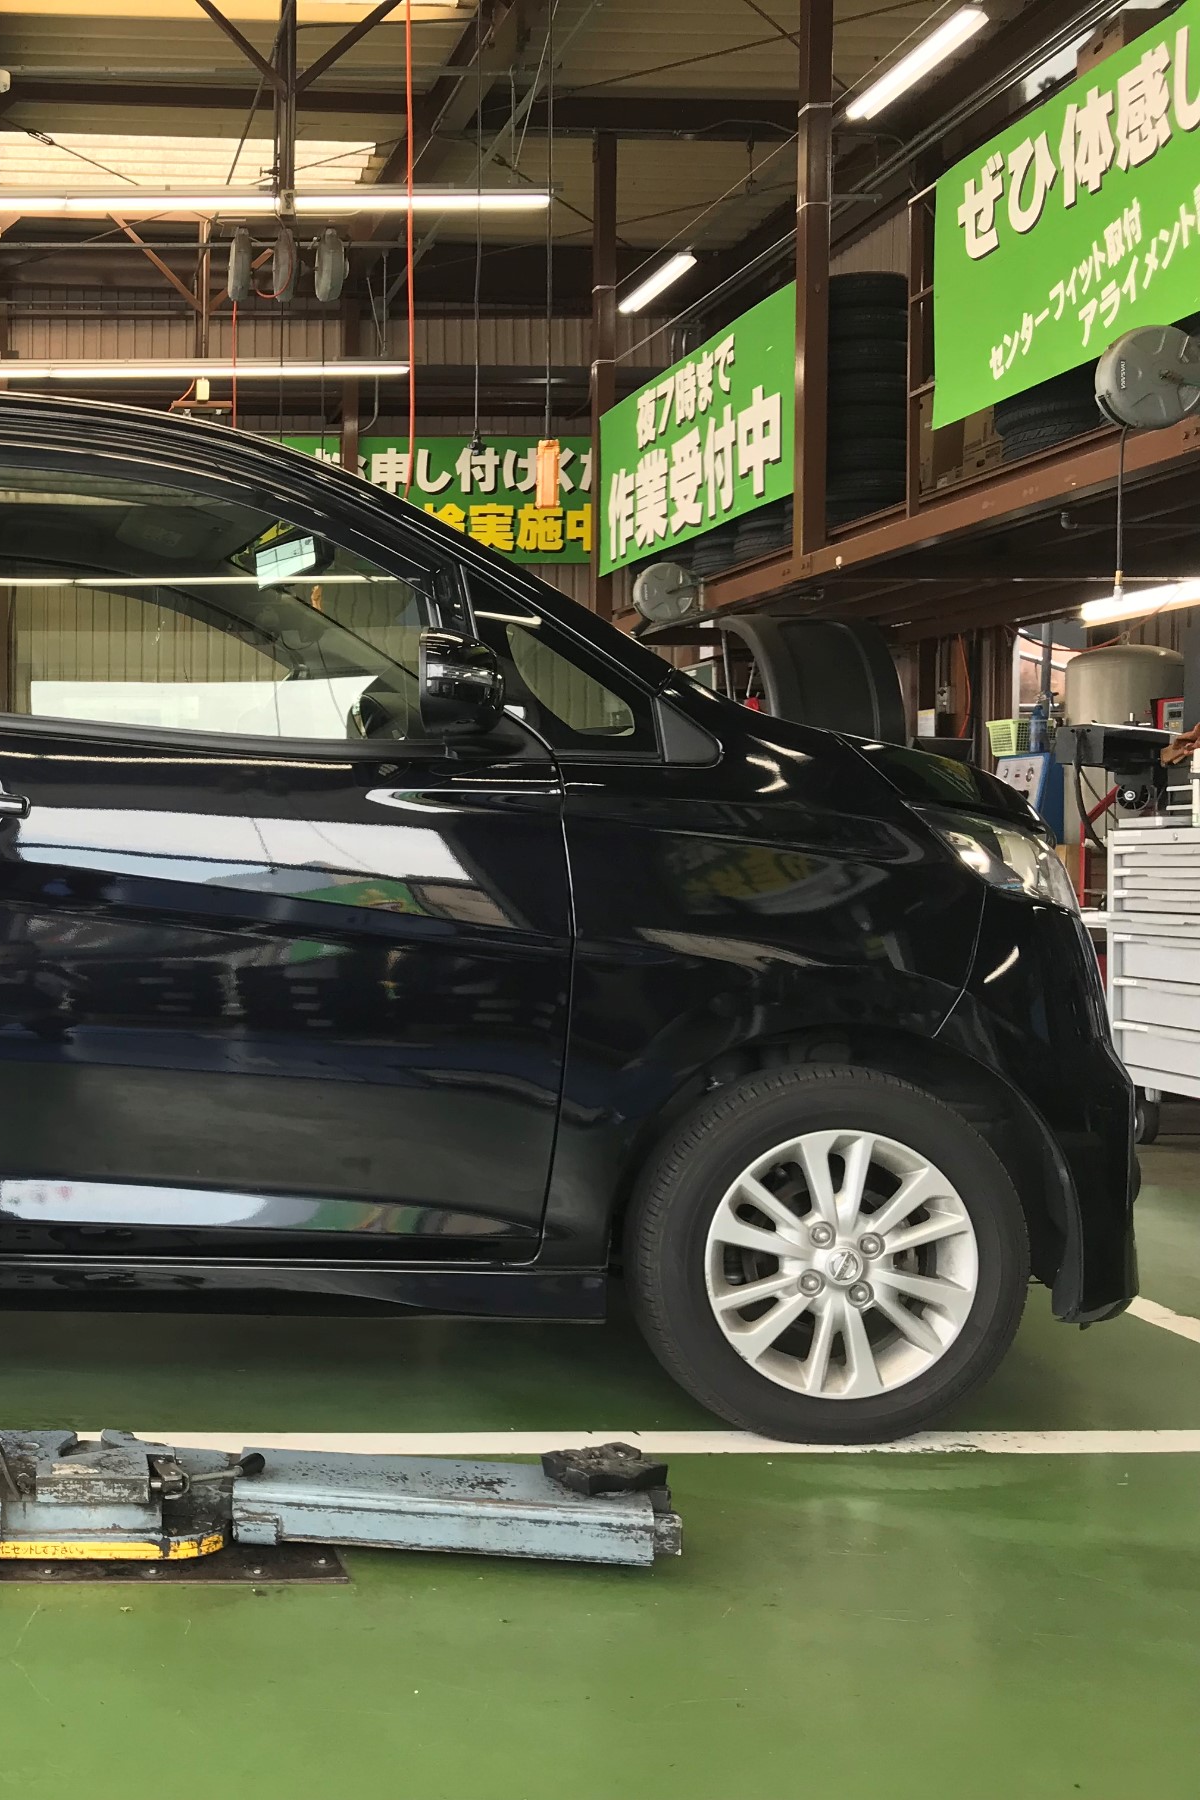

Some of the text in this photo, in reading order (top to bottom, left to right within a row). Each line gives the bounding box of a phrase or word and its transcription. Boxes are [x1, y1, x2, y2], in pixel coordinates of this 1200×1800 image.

[957, 25, 1200, 260] ぜひ体感し
[989, 196, 1143, 381] センターフィット取付
[1078, 183, 1200, 348] アライメント
[608, 385, 782, 561] 作業受付中
